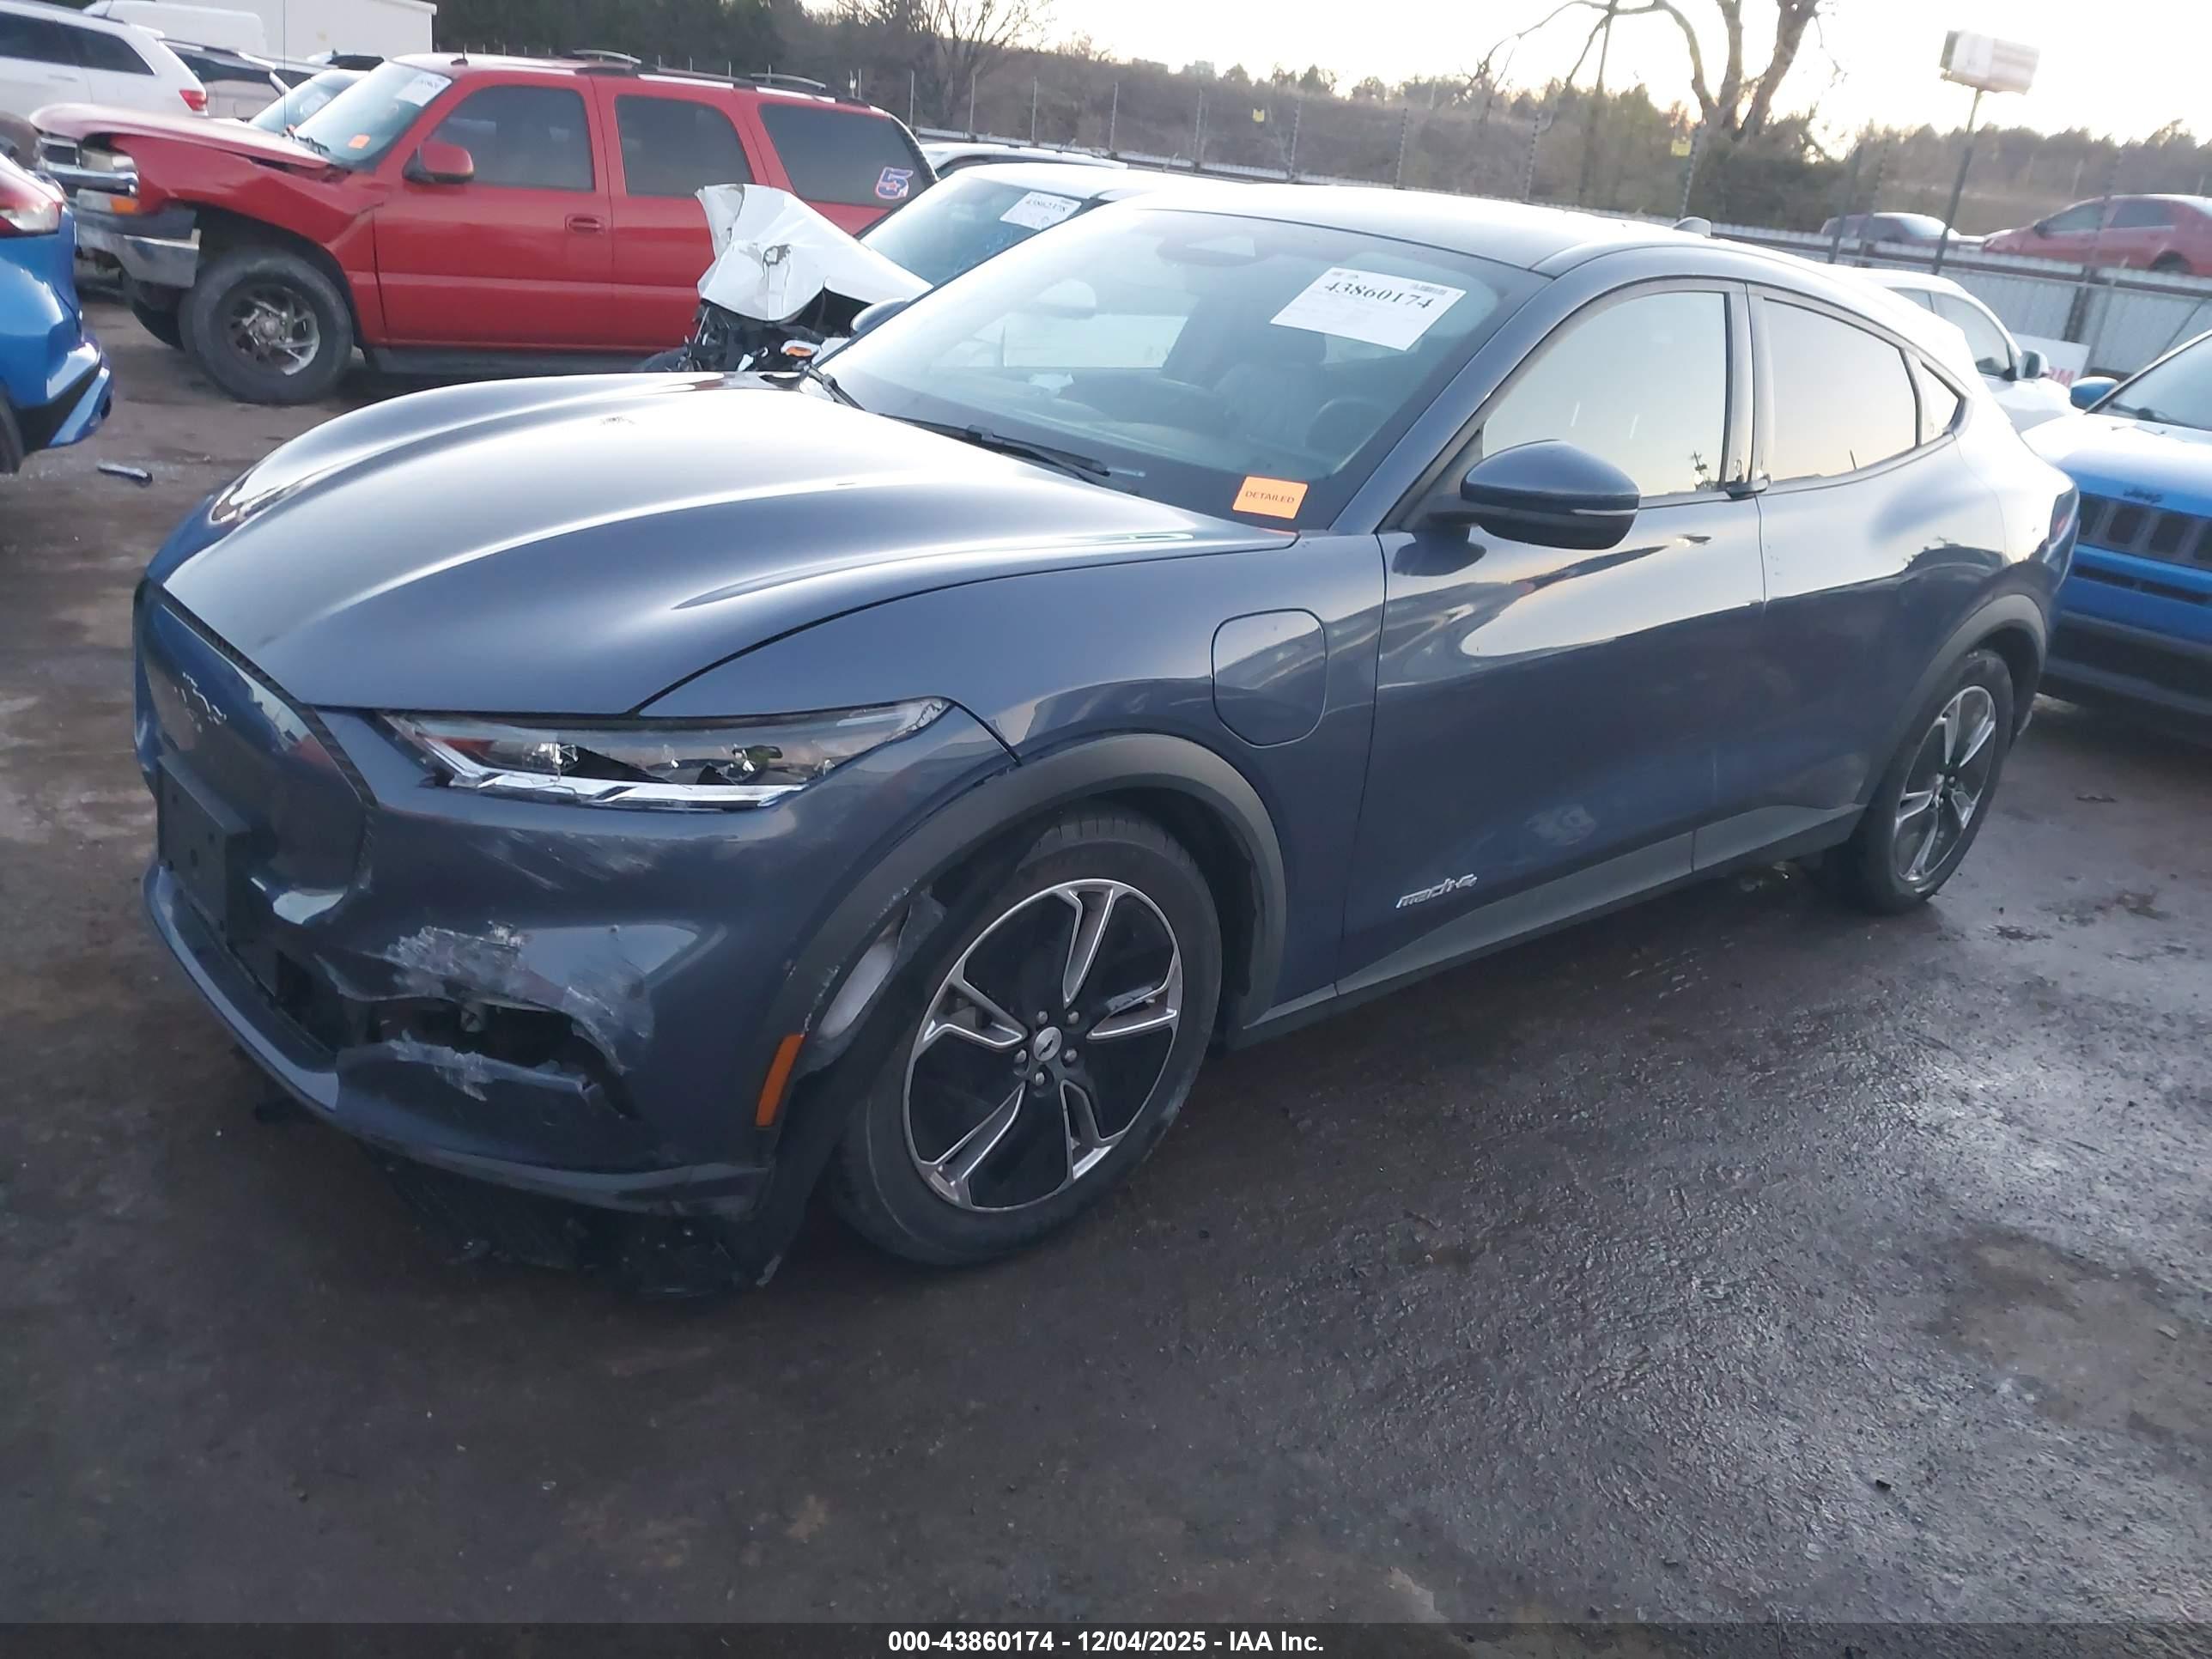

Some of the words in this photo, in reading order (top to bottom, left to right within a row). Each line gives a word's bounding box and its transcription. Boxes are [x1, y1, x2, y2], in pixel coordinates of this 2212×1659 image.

[877, 167, 914, 199] 5
[1324, 281, 1435, 309] 43860174
[1245, 490, 1295, 503] DETAILED
